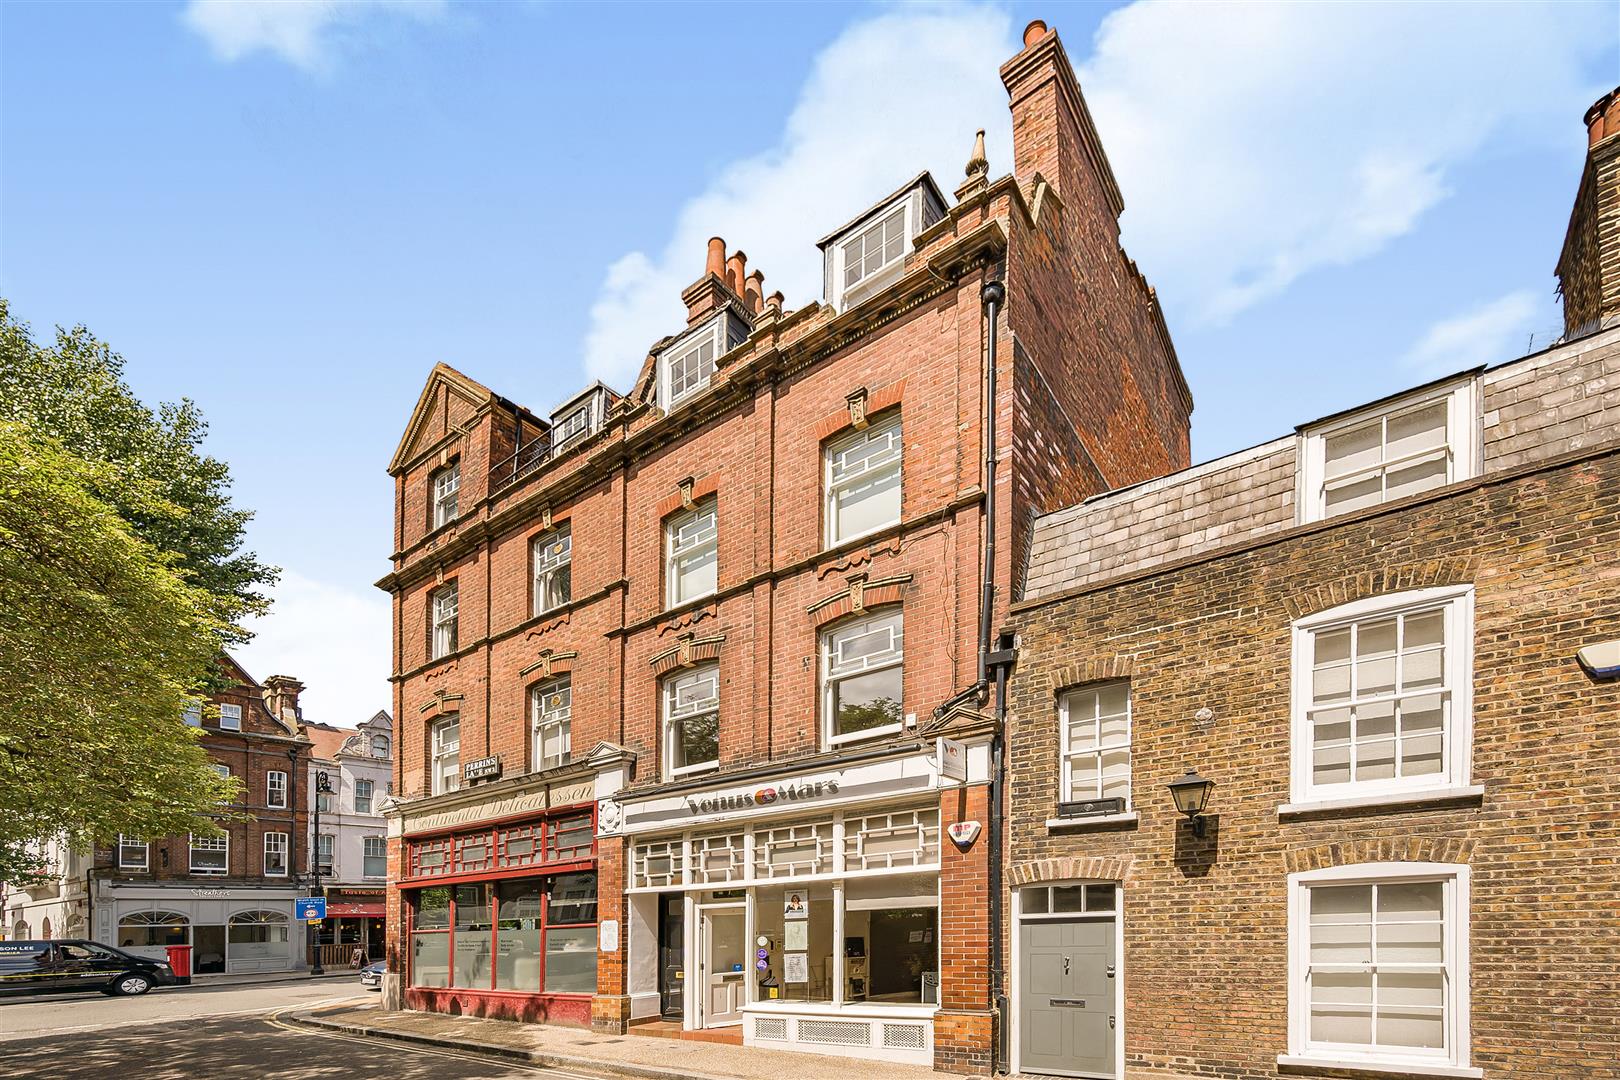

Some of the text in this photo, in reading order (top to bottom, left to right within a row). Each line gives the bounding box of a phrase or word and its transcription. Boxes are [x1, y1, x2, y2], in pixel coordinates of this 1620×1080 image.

[466, 757, 496, 772] PERRINS
[687, 793, 755, 815] Venus
[777, 779, 840, 801] Mars
[413, 801, 486, 830] Continental
